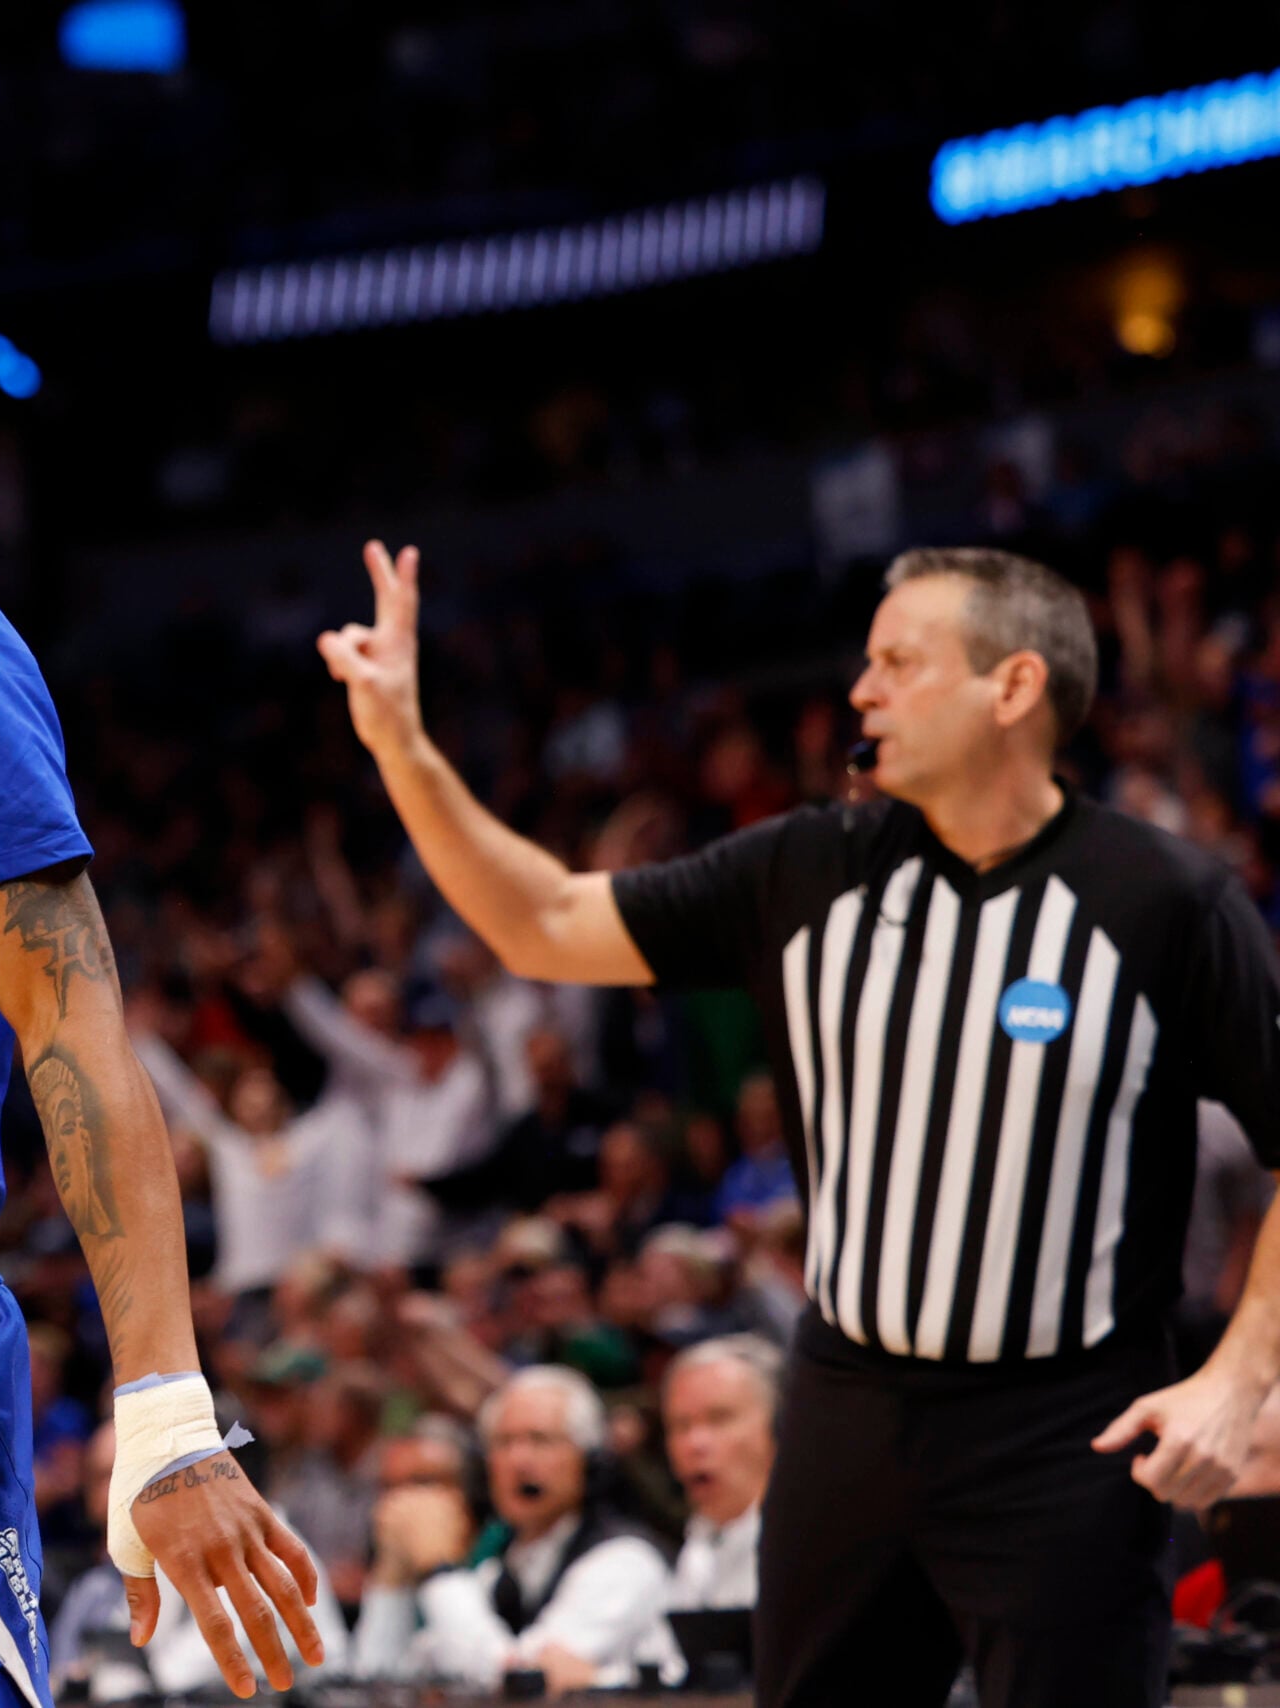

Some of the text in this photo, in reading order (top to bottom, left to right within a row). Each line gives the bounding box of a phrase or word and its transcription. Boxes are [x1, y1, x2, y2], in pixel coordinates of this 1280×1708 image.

[1006, 1004, 1065, 1031] NCAA
[184, 1465, 209, 1488] On
[211, 1461, 239, 1480] Me
